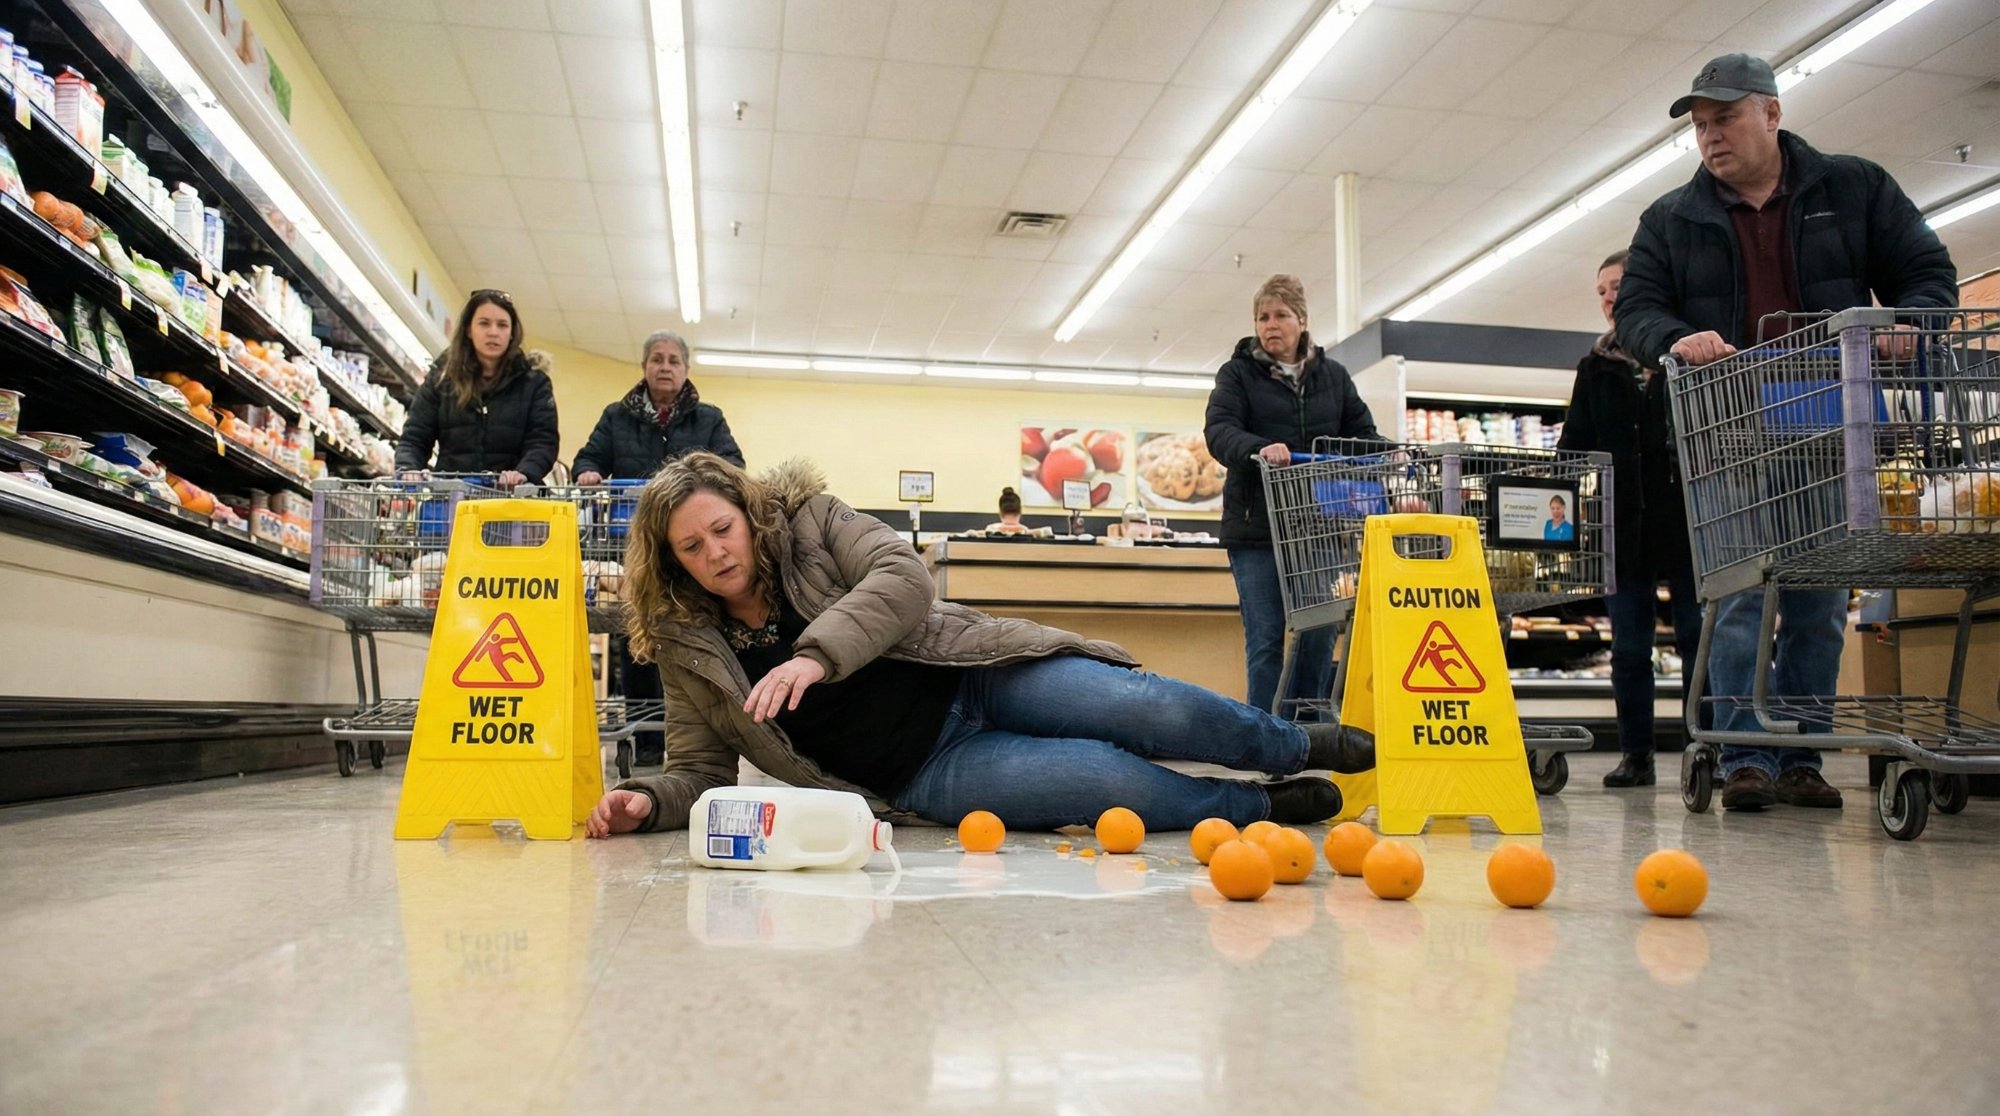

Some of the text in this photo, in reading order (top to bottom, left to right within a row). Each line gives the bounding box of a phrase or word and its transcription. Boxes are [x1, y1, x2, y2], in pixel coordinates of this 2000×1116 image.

[459, 577, 558, 599] CAUTION
[1389, 587, 1480, 608] CAUTION
[470, 696, 523, 717] WET
[1422, 701, 1469, 719] WET
[452, 723, 534, 744] FLOOR
[1414, 726, 1488, 745] FLOOR
